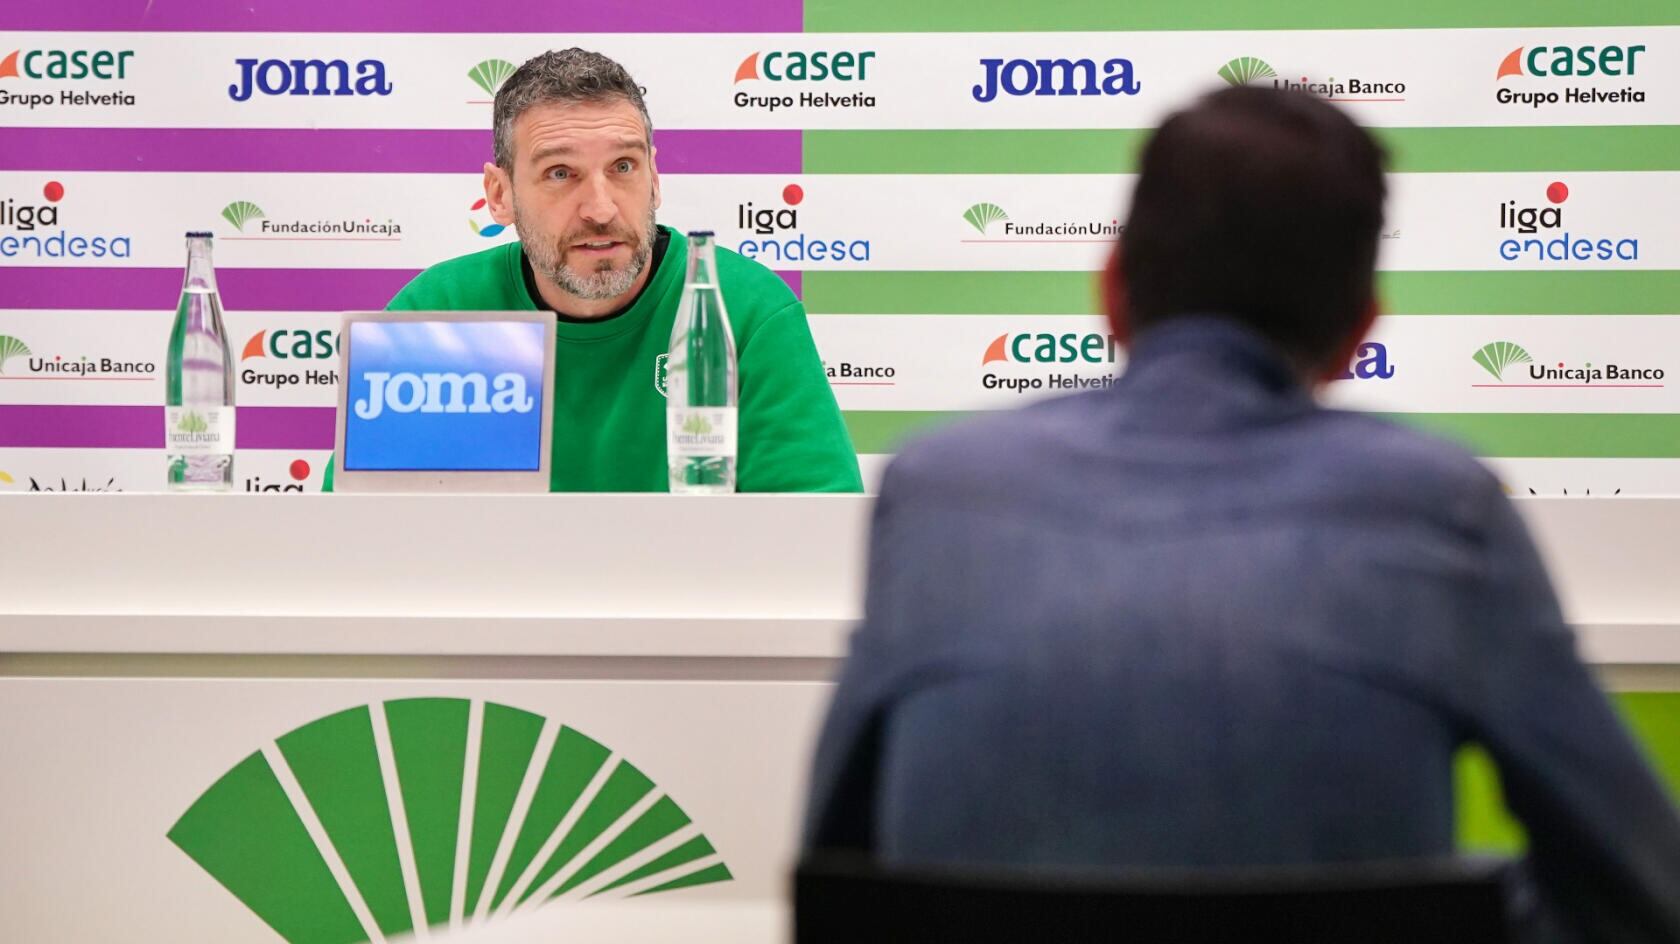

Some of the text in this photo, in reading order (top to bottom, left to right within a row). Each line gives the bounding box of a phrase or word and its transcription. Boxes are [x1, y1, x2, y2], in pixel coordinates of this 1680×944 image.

[24, 50, 135, 79] caser
[763, 51, 876, 81] caser
[1527, 45, 1646, 77] caser
[60, 90, 135, 106] Helvetia
[734, 91, 876, 110] Grupo Helvetia
[1349, 79, 1406, 94] Banco
[1496, 87, 1646, 109] Grupo Helvetia
[1, 198, 57, 231] liga
[739, 202, 797, 234] liga
[1500, 200, 1561, 234] liga
[0, 230, 130, 258] endesa
[739, 233, 870, 261] endesa
[1500, 232, 1638, 261] endesa
[270, 329, 340, 360] cas
[29, 356, 155, 377] Unicaja Banco
[241, 369, 300, 390] Grupo
[840, 362, 896, 378] Banco
[1529, 362, 1665, 384] Unicaja Banco
[982, 373, 1043, 394] Grupo
